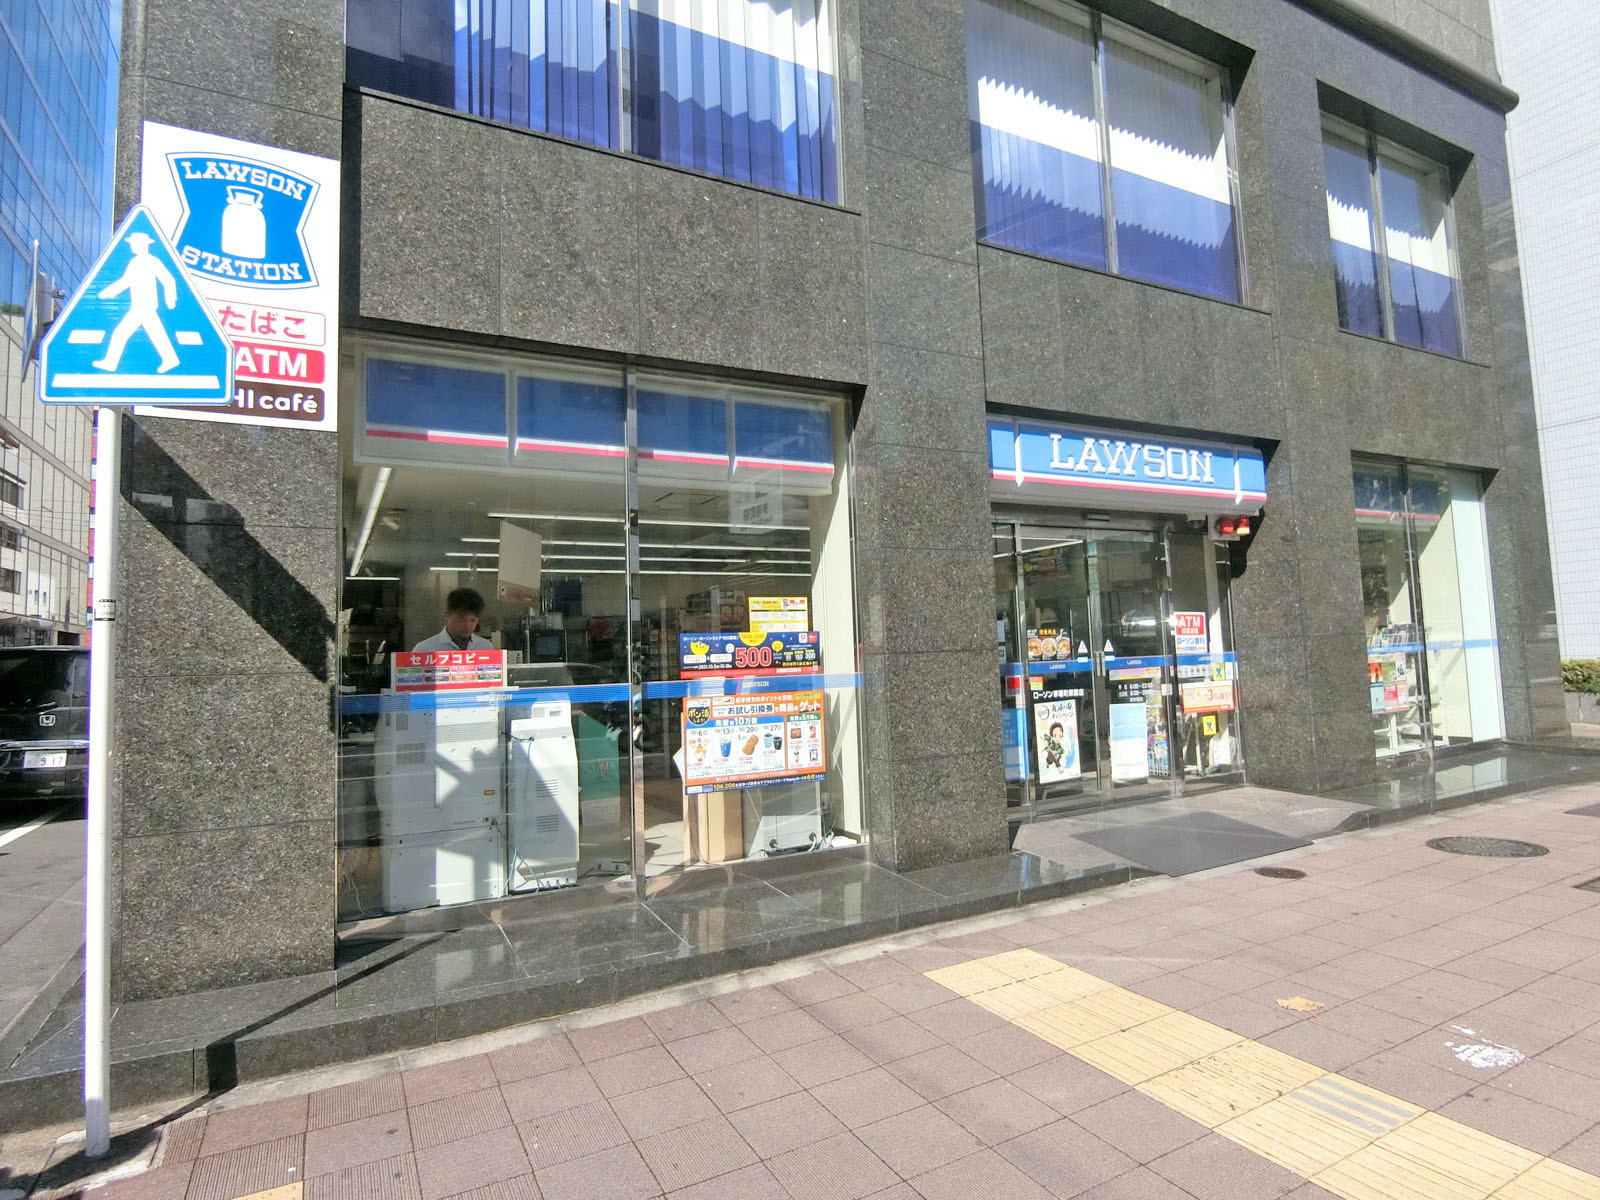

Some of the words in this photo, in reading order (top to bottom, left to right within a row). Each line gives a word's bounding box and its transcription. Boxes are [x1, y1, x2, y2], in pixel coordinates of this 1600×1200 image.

[181, 161, 307, 201] LAWSON
[182, 245, 304, 282] STATION
[218, 305, 307, 339] たばこ
[235, 346, 308, 378] ATM
[259, 393, 318, 414] café
[1049, 433, 1216, 484] LAWSON
[1178, 616, 1201, 628] ATM
[410, 653, 490, 665] セルフコピー
[735, 646, 772, 668] 500
[727, 704, 773, 715] お試し引換券
